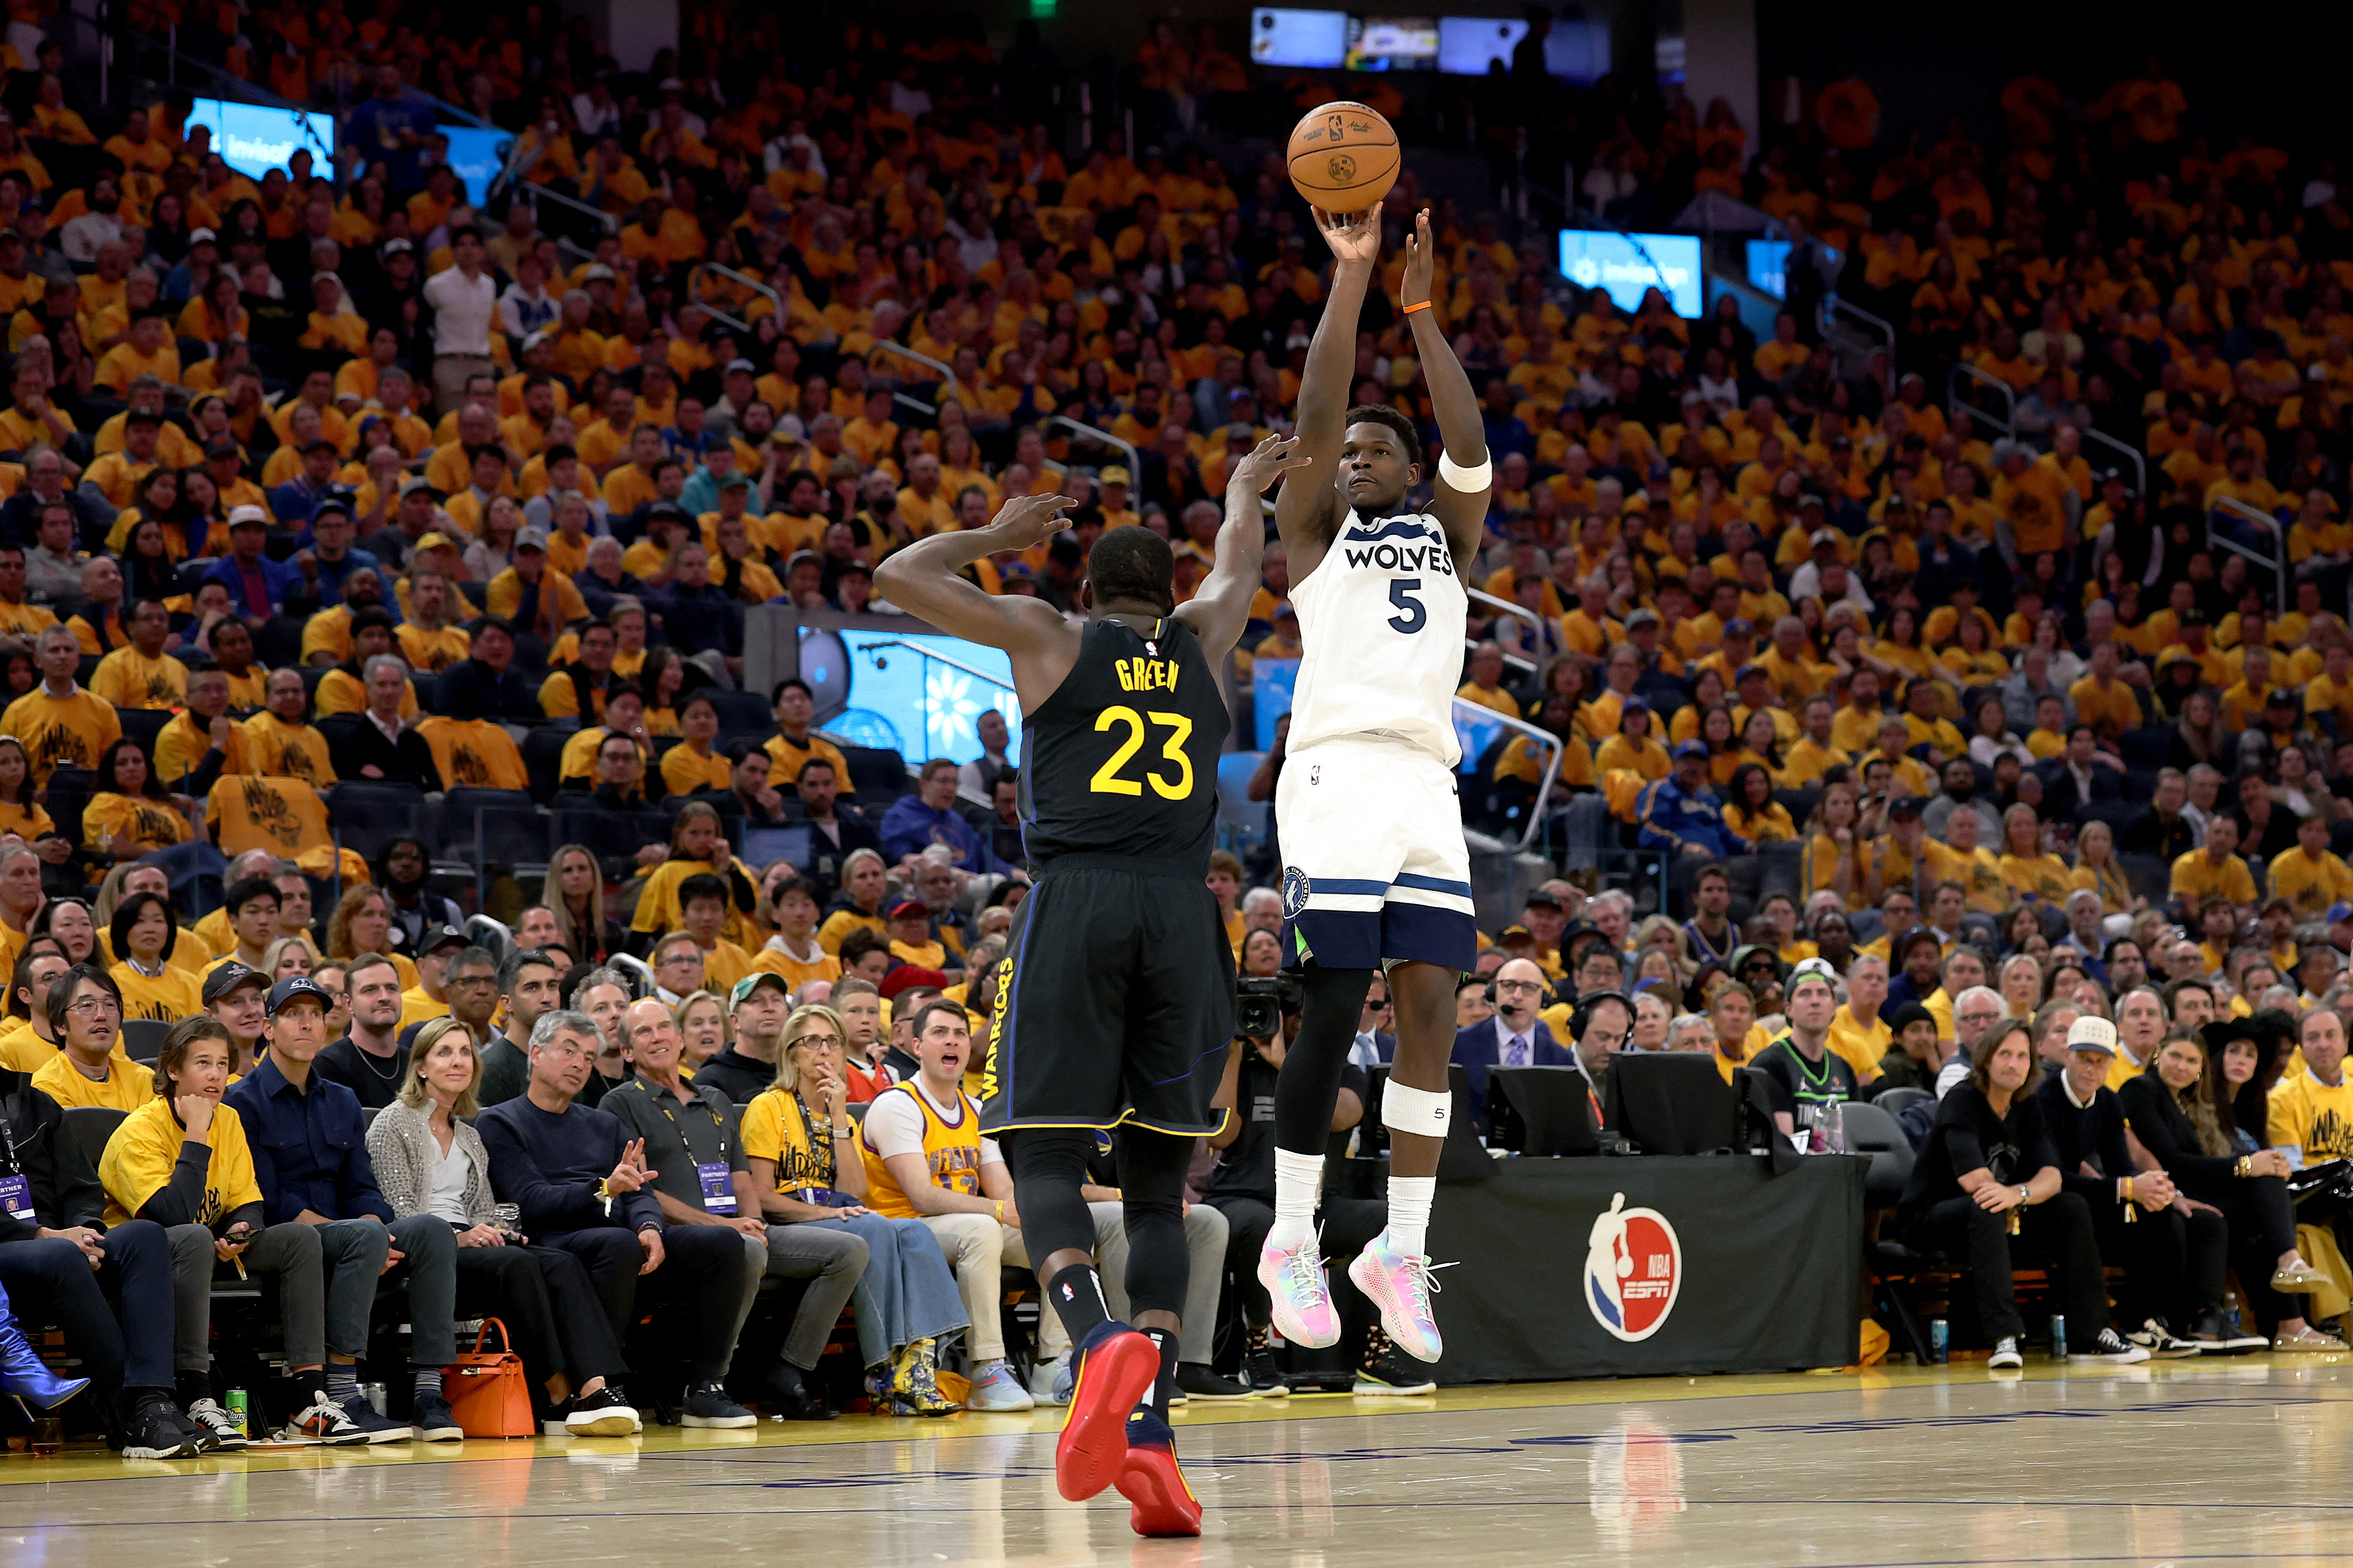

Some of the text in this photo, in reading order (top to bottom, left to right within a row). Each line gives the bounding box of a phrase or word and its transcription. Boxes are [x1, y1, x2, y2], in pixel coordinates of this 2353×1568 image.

[1345, 544, 1452, 576] WOLVES
[1388, 578, 1427, 635] 5
[1115, 656, 1180, 693] GREEN
[1090, 705, 1194, 800] 23
[982, 957, 1014, 1102] WARRIORS
[1434, 1108, 1445, 1119] 5
[0, 1184, 22, 1194] RTNER
[1647, 1254, 1671, 1278] NBA
[1623, 1280, 1670, 1299] ESPN
[227, 1409, 246, 1424] Starry
